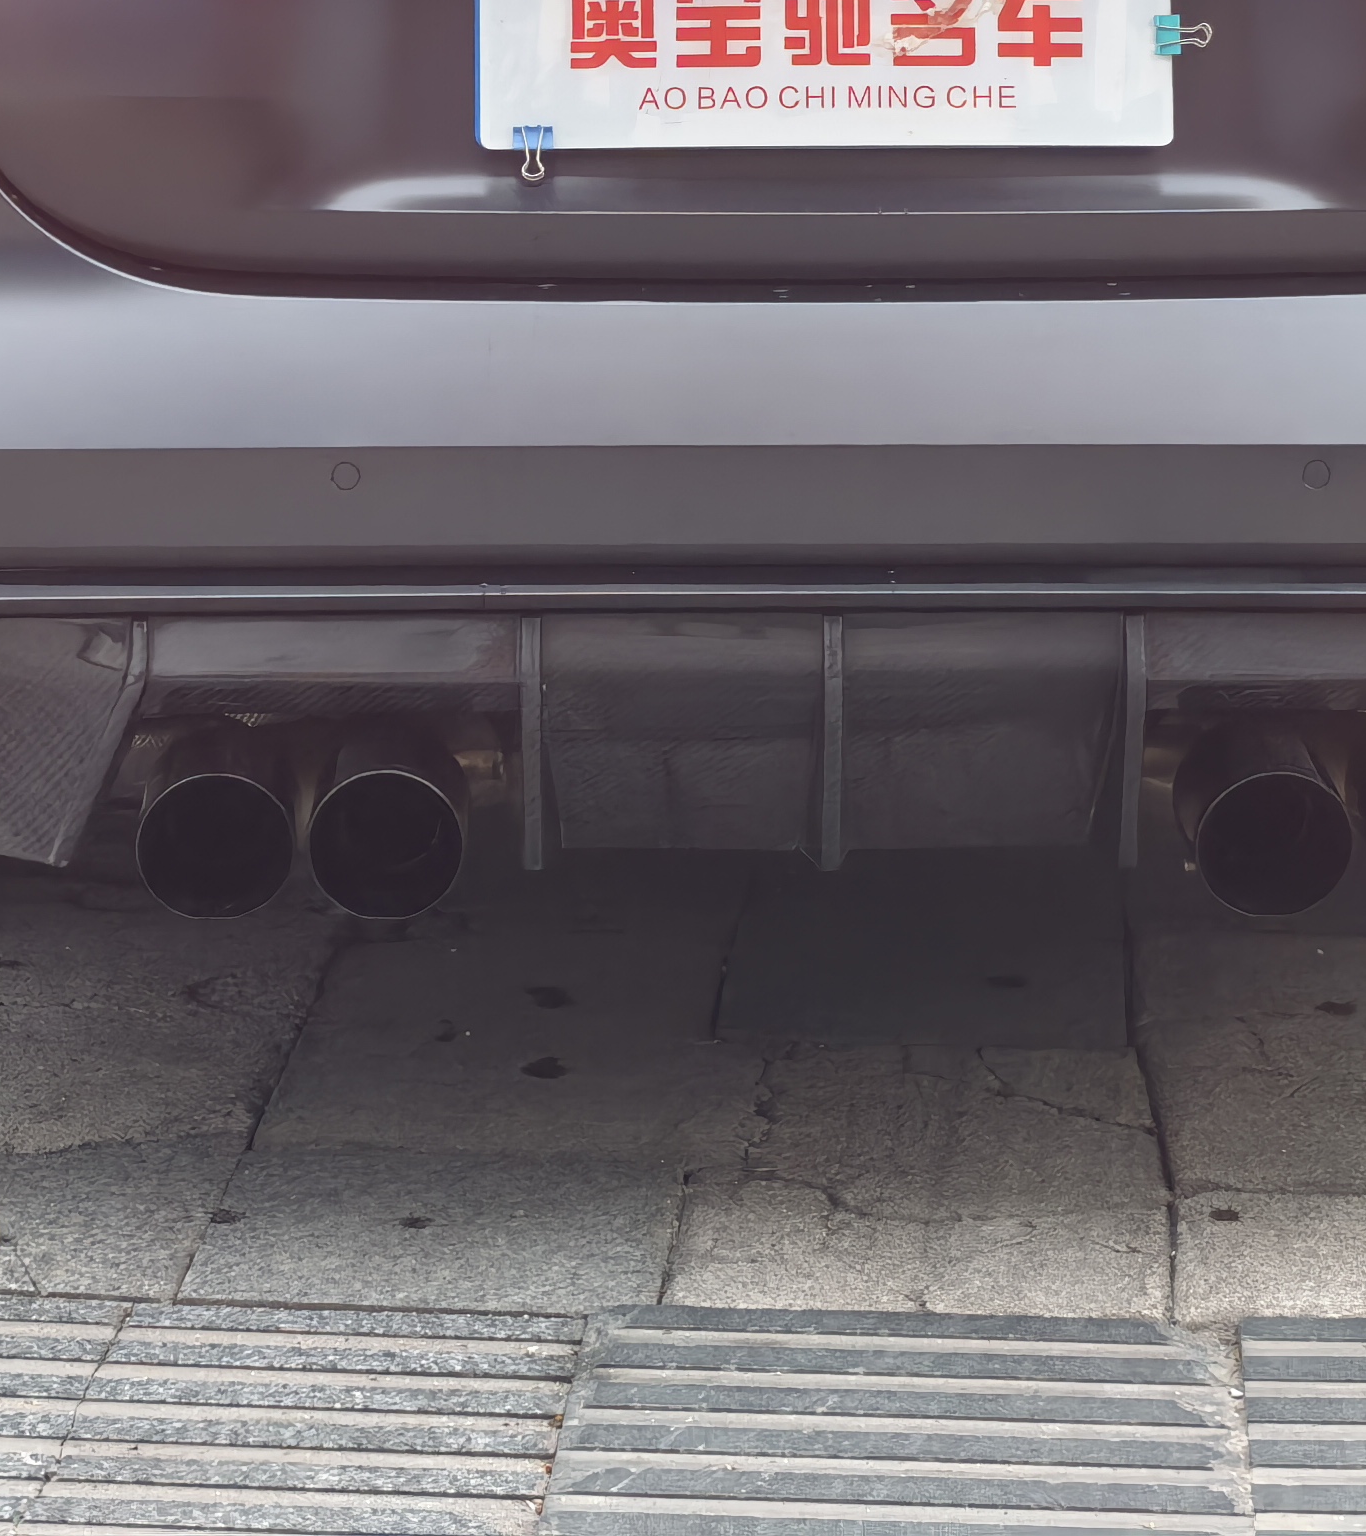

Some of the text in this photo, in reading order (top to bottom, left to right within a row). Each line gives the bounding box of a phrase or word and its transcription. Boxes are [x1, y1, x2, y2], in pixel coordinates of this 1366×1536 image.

[638, 85, 1017, 111] AO BAO CHI MING CHE
